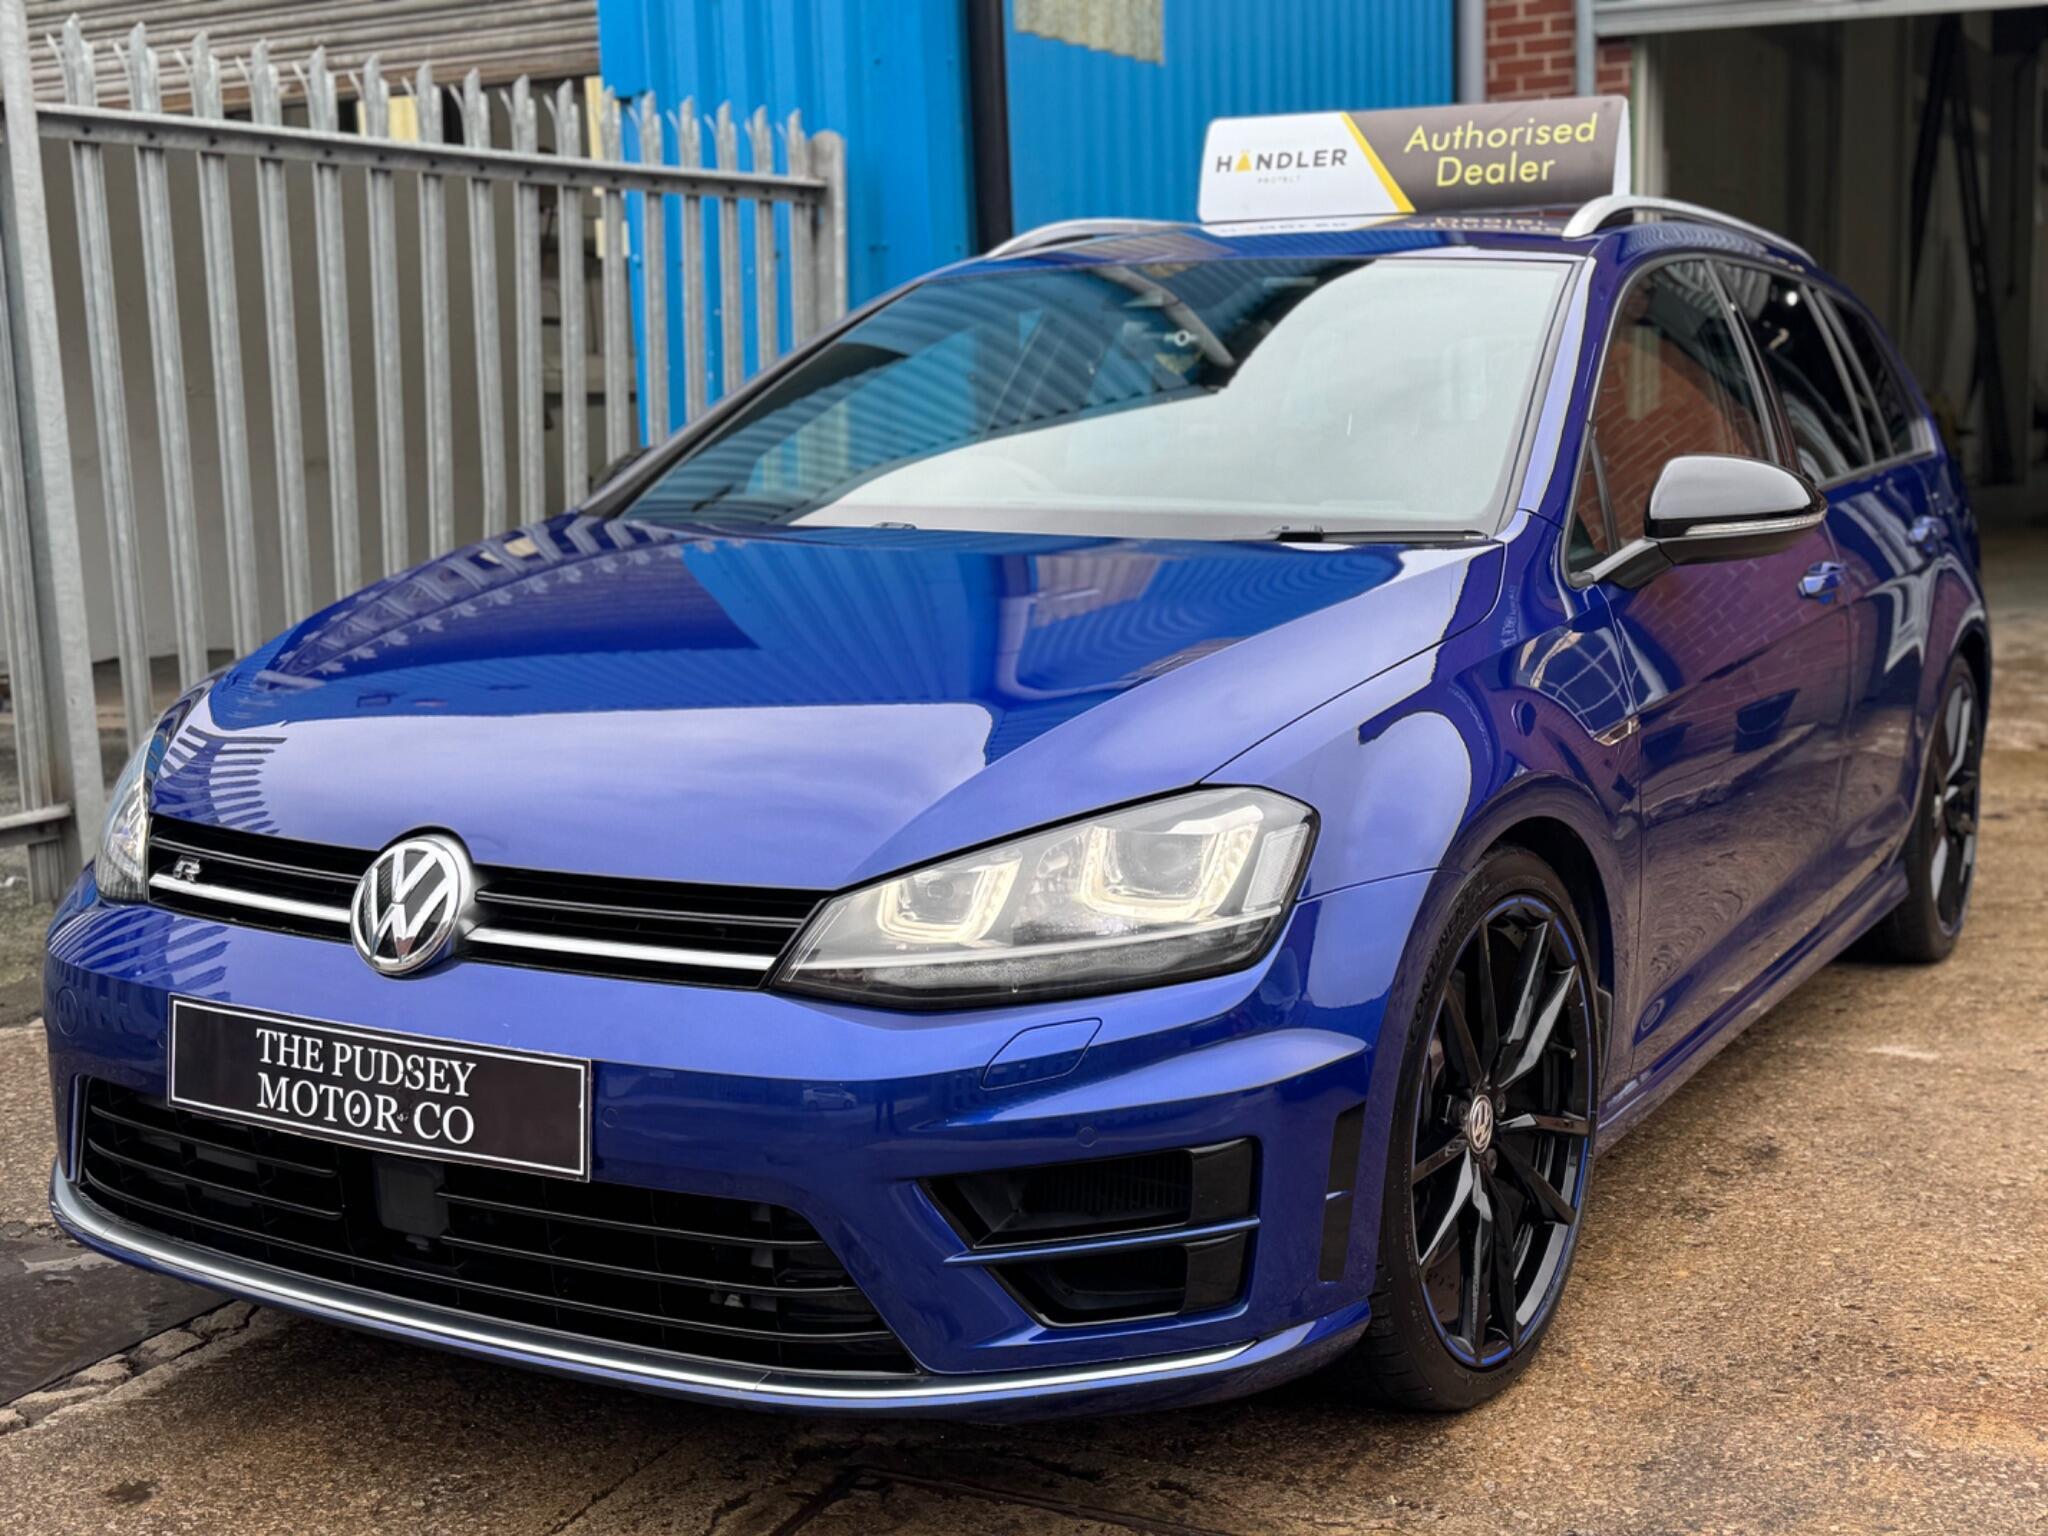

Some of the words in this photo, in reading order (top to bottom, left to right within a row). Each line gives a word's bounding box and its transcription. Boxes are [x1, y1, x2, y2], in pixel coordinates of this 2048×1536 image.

[1404, 113, 1597, 153] Authorised
[1436, 151, 1555, 187] Dealer
[173, 856, 201, 880] R
[256, 1027, 324, 1074] THE
[333, 1041, 477, 1097] PUDSEY
[256, 1072, 402, 1134] MOTOR
[413, 1105, 475, 1144] CO
